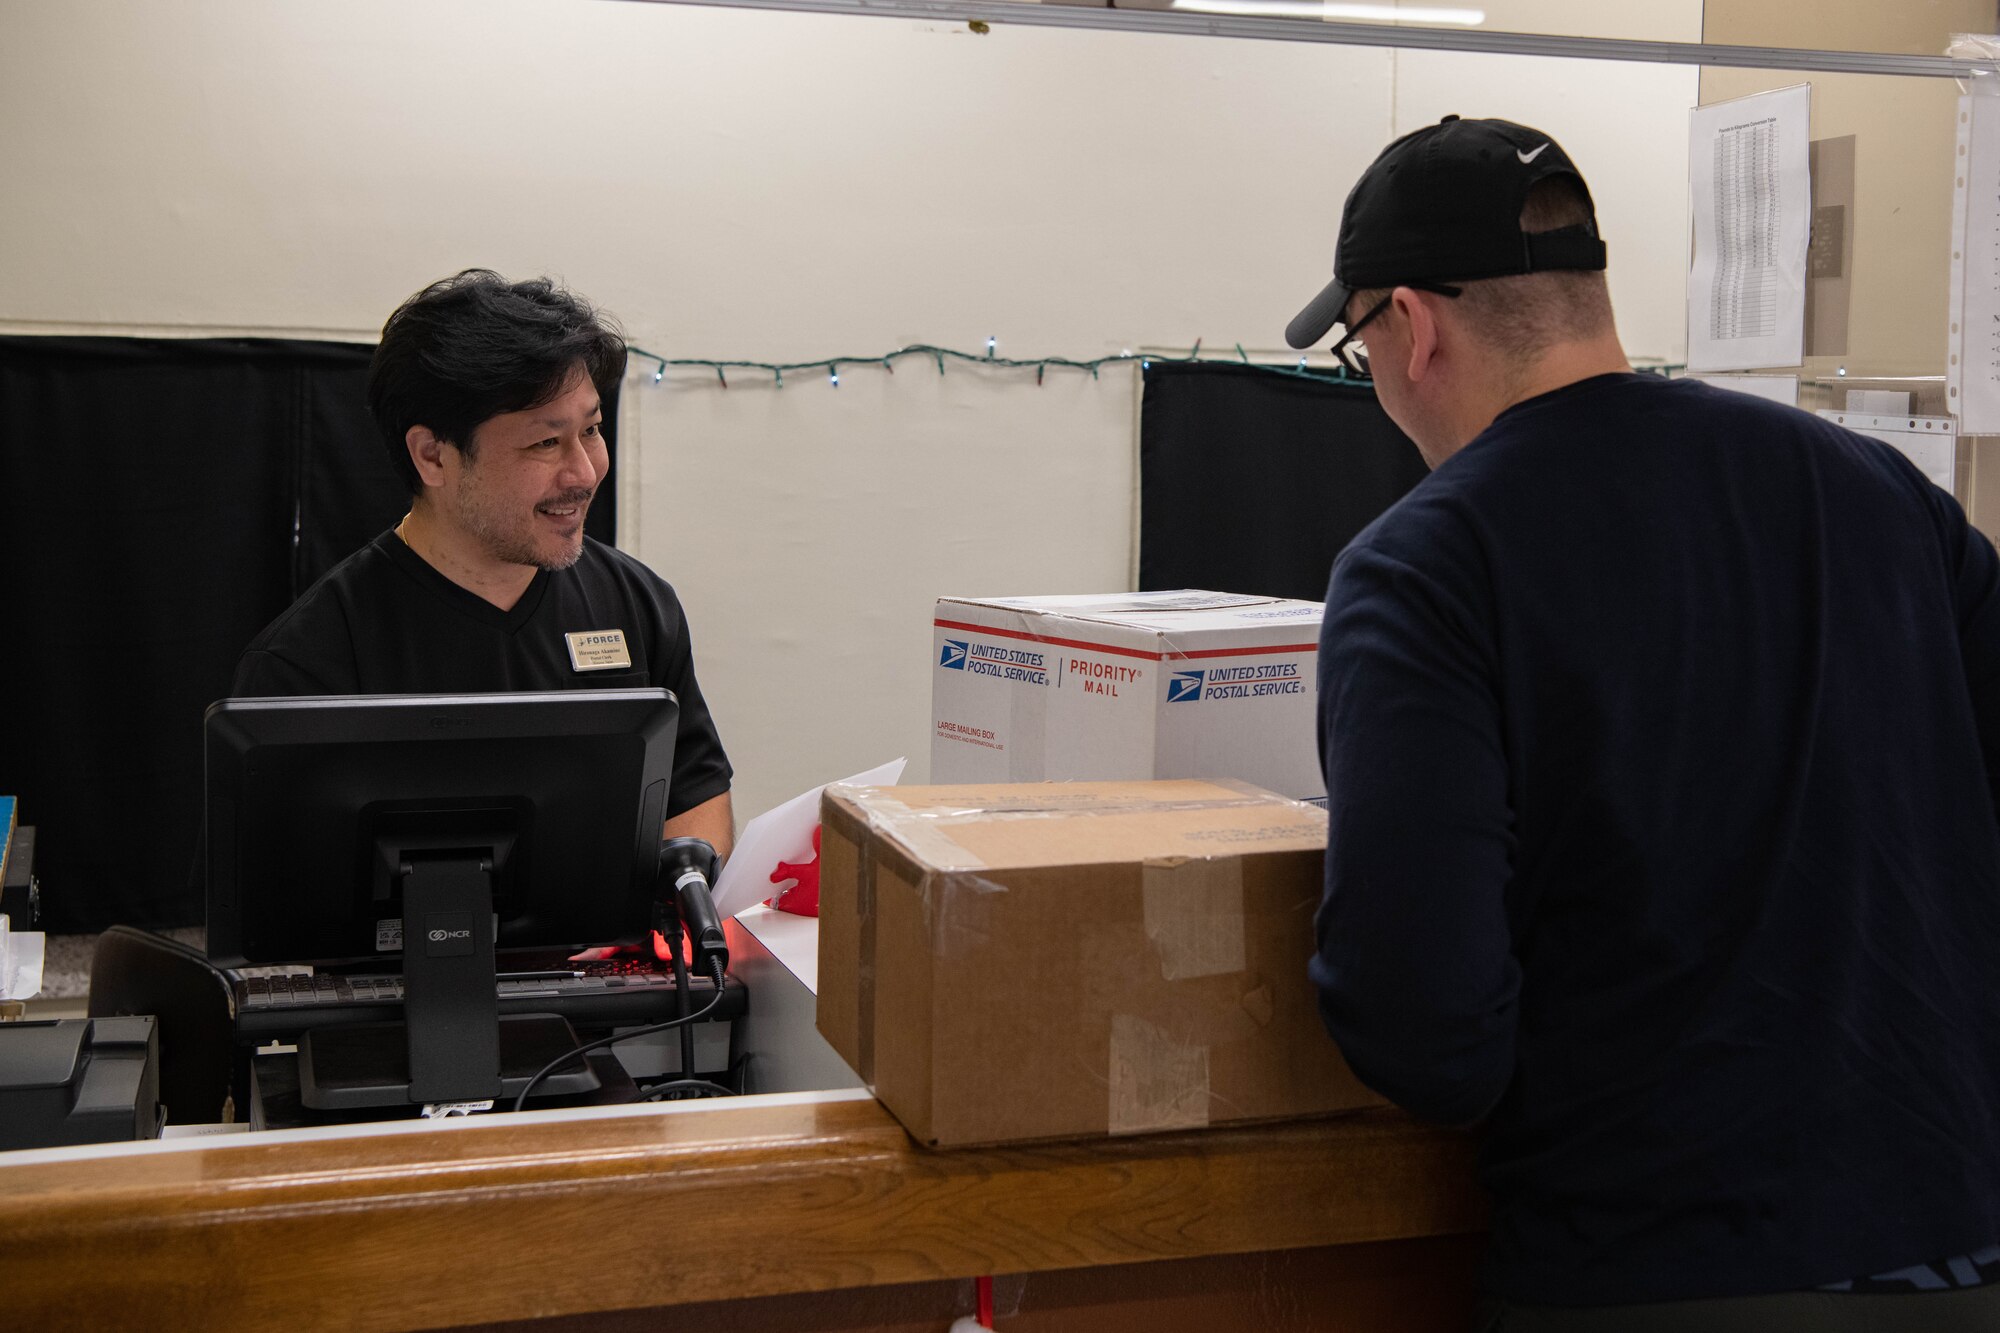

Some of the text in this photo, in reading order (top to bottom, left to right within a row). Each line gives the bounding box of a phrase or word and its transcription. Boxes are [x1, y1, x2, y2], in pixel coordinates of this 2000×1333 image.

[587, 635, 621, 644] FORCE
[971, 644, 1044, 667] UNITED STATES
[968, 661, 1002, 678] POSTAL
[1209, 663, 1297, 681] UNITED STATES
[1084, 680, 1118, 697] MAIL
[1205, 684, 1249, 700] POSTAL
[937, 721, 995, 740] LARGE MAILING BOX
[448, 930, 470, 938] NCR
